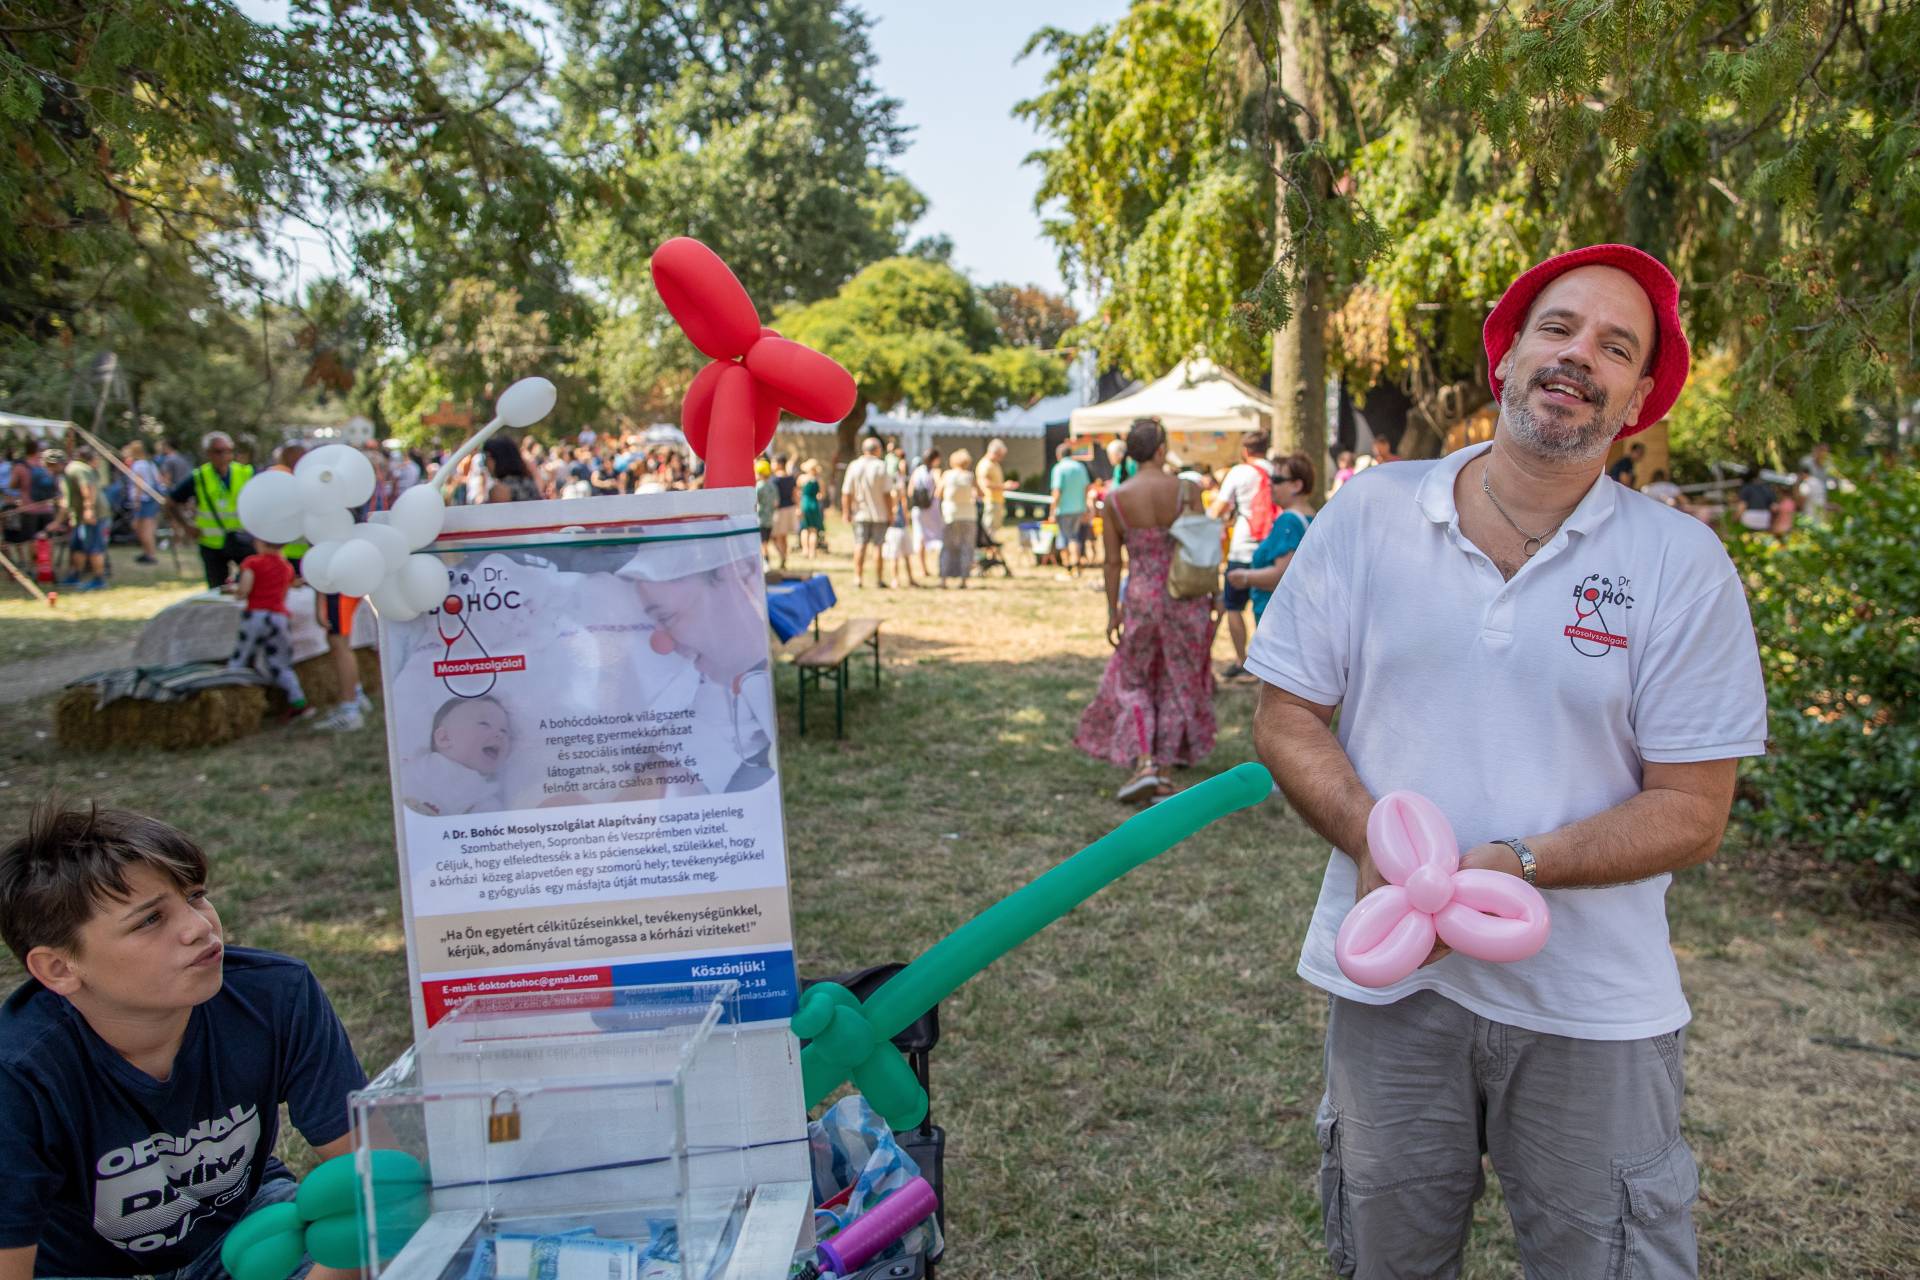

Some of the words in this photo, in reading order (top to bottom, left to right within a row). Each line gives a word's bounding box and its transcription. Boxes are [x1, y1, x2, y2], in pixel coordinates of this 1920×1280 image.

[484, 567, 508, 582] Dr.
[1618, 576, 1632, 589] Dr.
[429, 587, 521, 615] OHÓC
[1567, 628, 1628, 646] Mosolyszolgála
[437, 658, 523, 674] Mosolyszolgálat
[540, 719, 548, 730] A
[550, 713, 634, 729] bohócdoktorok
[636, 709, 696, 724] világszerte
[546, 734, 595, 747] rengeteg
[558, 749, 570, 760] és
[621, 742, 683, 755] intézményt
[547, 763, 610, 779] látogatnak,
[612, 761, 631, 772] sok
[634, 759, 682, 774] gyermek
[684, 755, 697, 767] és
[583, 778, 617, 790] arcára
[619, 774, 653, 787] csalva
[656, 771, 703, 785] mosolyt.
[443, 830, 450, 840] A
[452, 829, 468, 839] Dr.
[471, 825, 505, 838] Bohóc
[508, 819, 595, 834] Mosolyszolgálat
[598, 814, 657, 828] Alapítvány
[659, 812, 700, 823] csapata
[702, 807, 744, 822] jelenleg
[461, 840, 545, 854] Szombathelyen,
[547, 834, 606, 848] Sopronban
[608, 831, 619, 842] és
[621, 827, 692, 841] Veszprémben
[694, 823, 728, 835] vizitel.
[436, 859, 473, 874] Céljuk,
[475, 858, 501, 870] hogy
[575, 852, 581, 860] a
[583, 849, 598, 859] kis
[600, 843, 671, 861] páciensekkel,
[673, 838, 728, 853] szüleikkel,
[730, 837, 756, 850] hogy
[430, 879, 437, 887] a
[439, 873, 477, 886] kórházi
[483, 872, 514, 884] közeg
[576, 866, 594, 878] egy
[597, 859, 642, 873] szomorú
[672, 850, 765, 867] tevékenységükkel
[480, 890, 486, 898] a
[488, 884, 541, 900] gyógyulás
[545, 884, 564, 895] egy
[567, 879, 611, 891] másfajta
[613, 875, 638, 889] útját
[640, 871, 691, 885] mutassák
[693, 872, 719, 882] meg.
[465, 926, 482, 939] Ön
[485, 923, 535, 940] egyetért
[645, 905, 762, 924] tevékenységünkkel,
[448, 944, 490, 959] kérjük,
[492, 937, 571, 954] adományával
[574, 934, 637, 947] támogassa
[640, 933, 647, 941] a
[650, 926, 693, 940] kórházi
[692, 960, 765, 977] Köszönjük!
[443, 983, 477, 994] E-mail:
[478, 974, 598, 990] doktorbohoc@gmail.com
